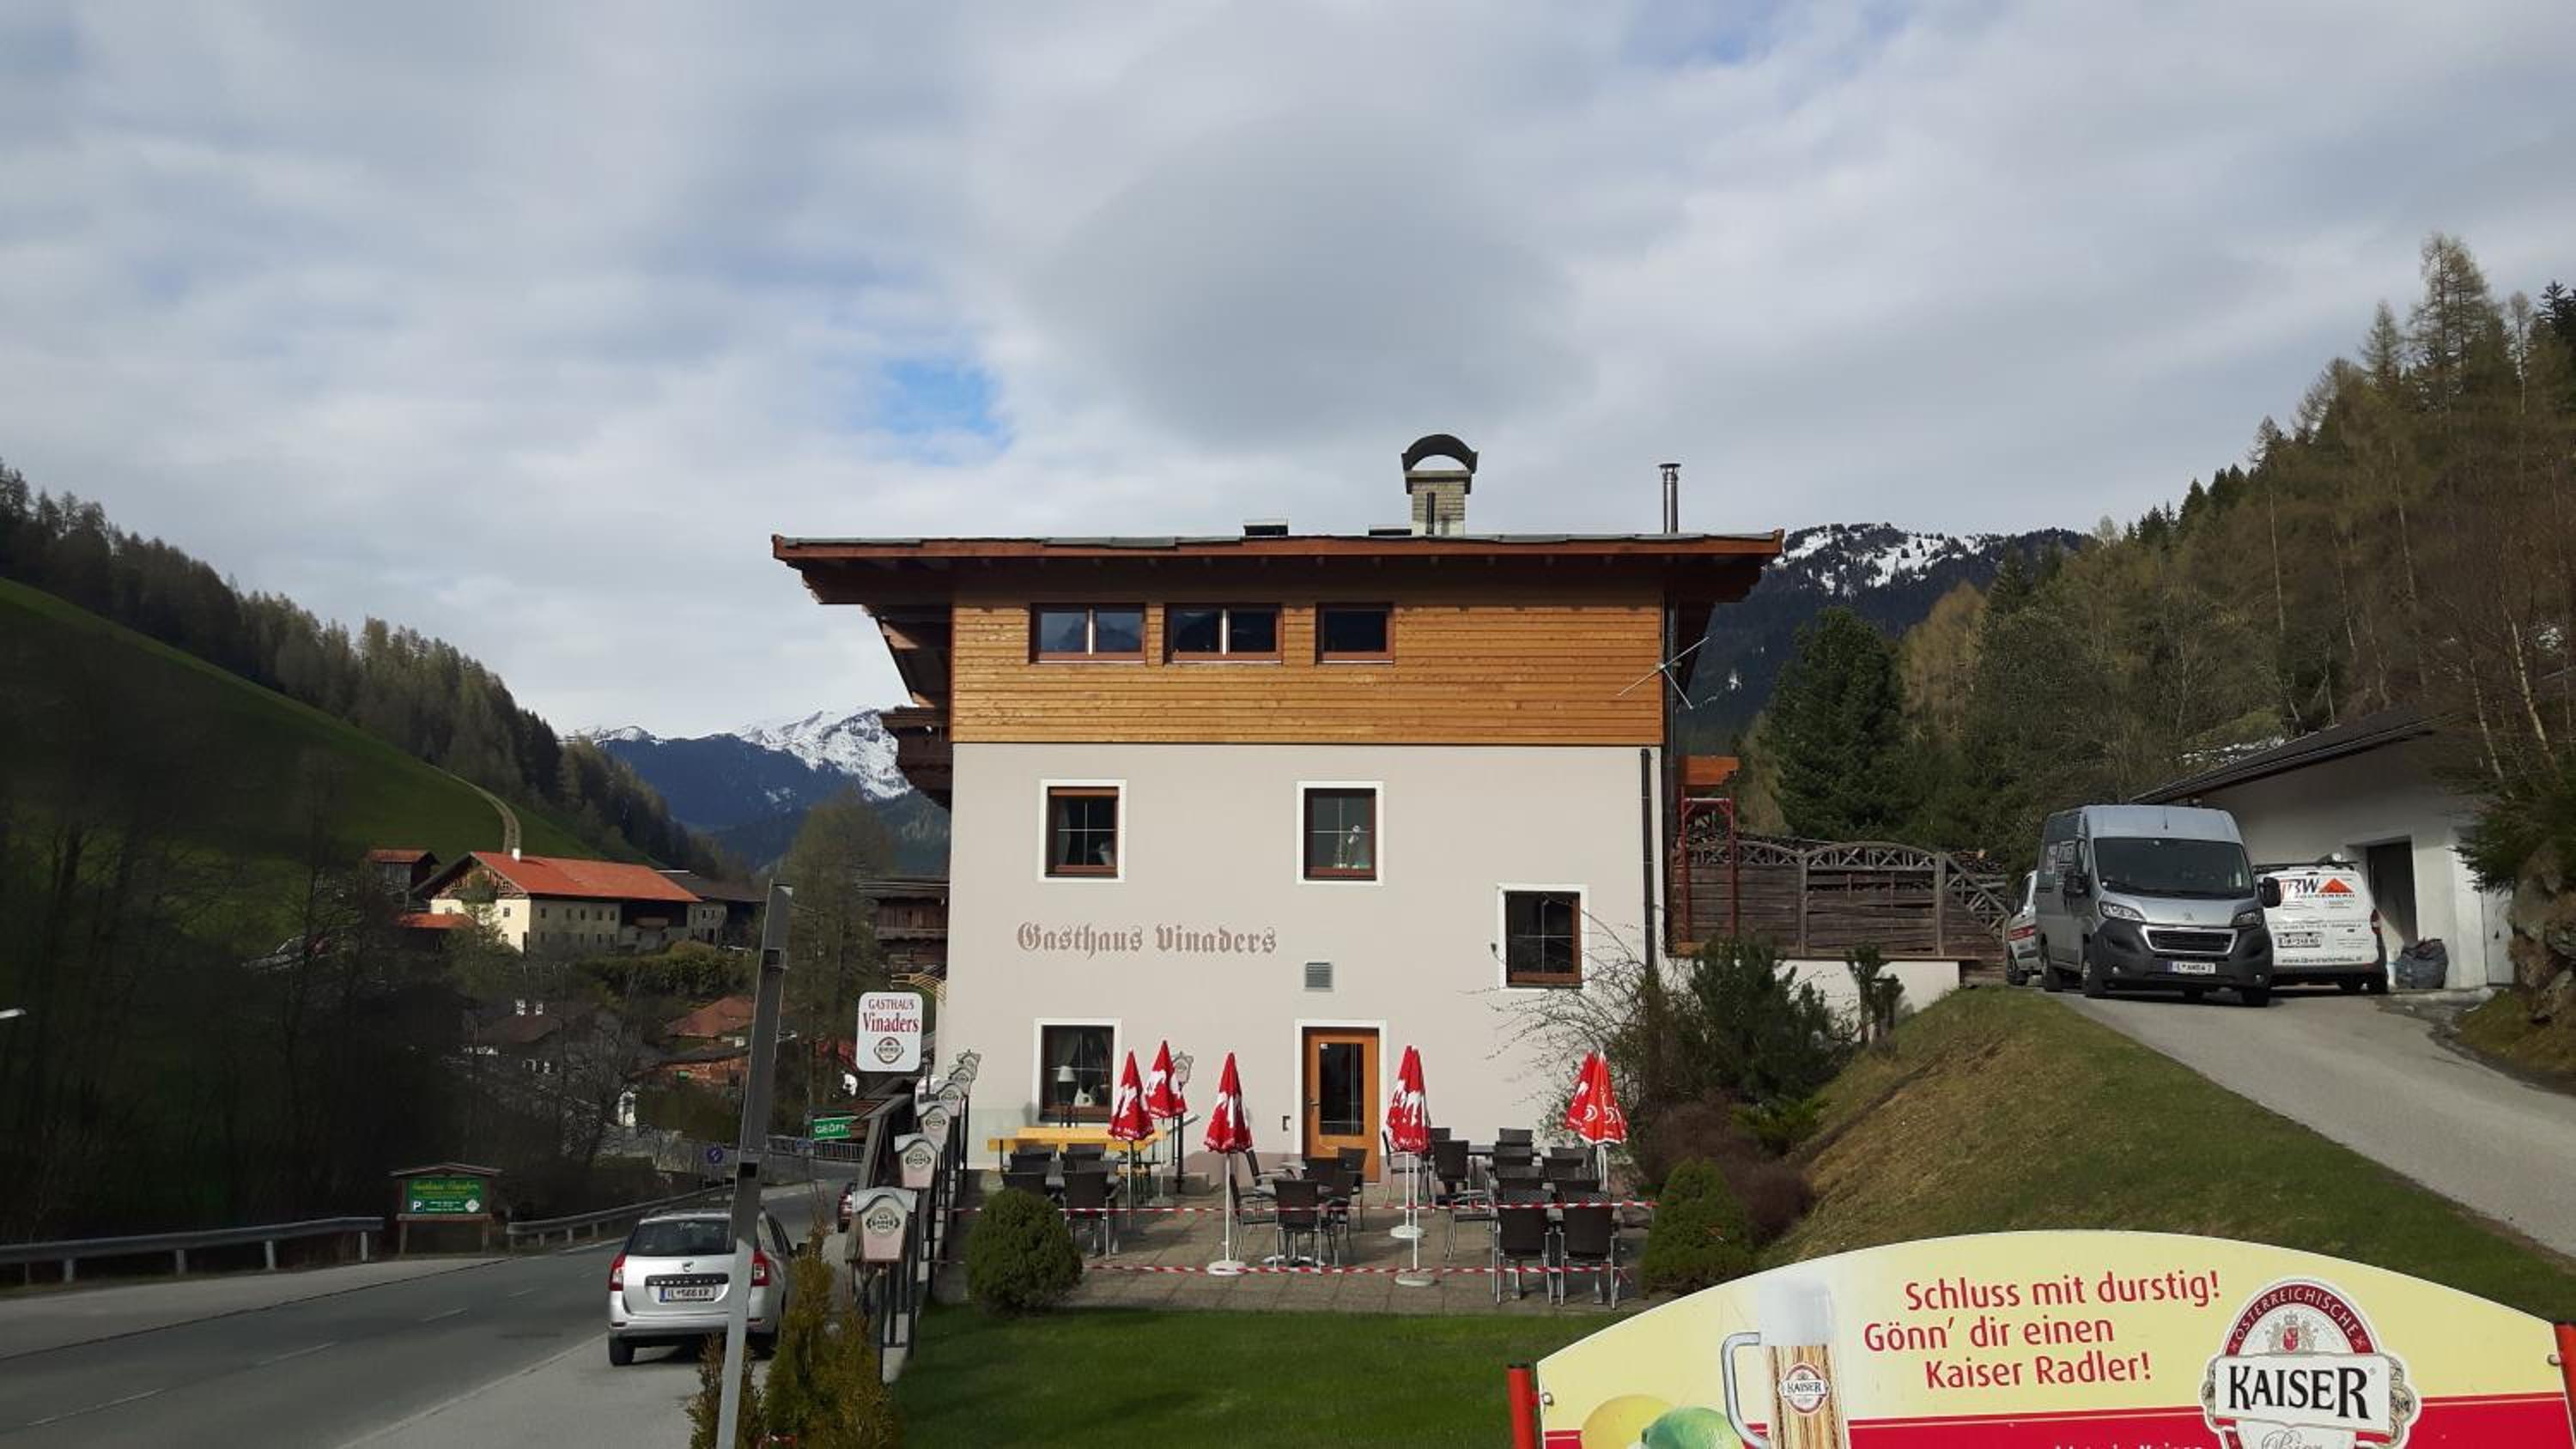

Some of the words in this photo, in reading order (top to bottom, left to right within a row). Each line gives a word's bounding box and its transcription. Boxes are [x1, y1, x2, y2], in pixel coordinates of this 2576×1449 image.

[1018, 922, 1143, 960] Gasthaus
[1156, 924, 1277, 954] Vinaders
[863, 1012, 920, 1033] Vinaders
[868, 998, 914, 1010] GASTHAUS
[1905, 1277, 2020, 1311] Schluss
[2032, 1274, 2087, 1306] mit
[2097, 1270, 2221, 1307] durstig!
[1970, 1315, 2011, 1348] dir
[2024, 1314, 2115, 1345] einen
[2234, 1286, 2360, 1341] ÖSTERREICHISCHE
[1925, 1356, 2024, 1389] Kaiser
[2035, 1351, 2152, 1384] Radler!
[2228, 1365, 2372, 1420] KAISER
